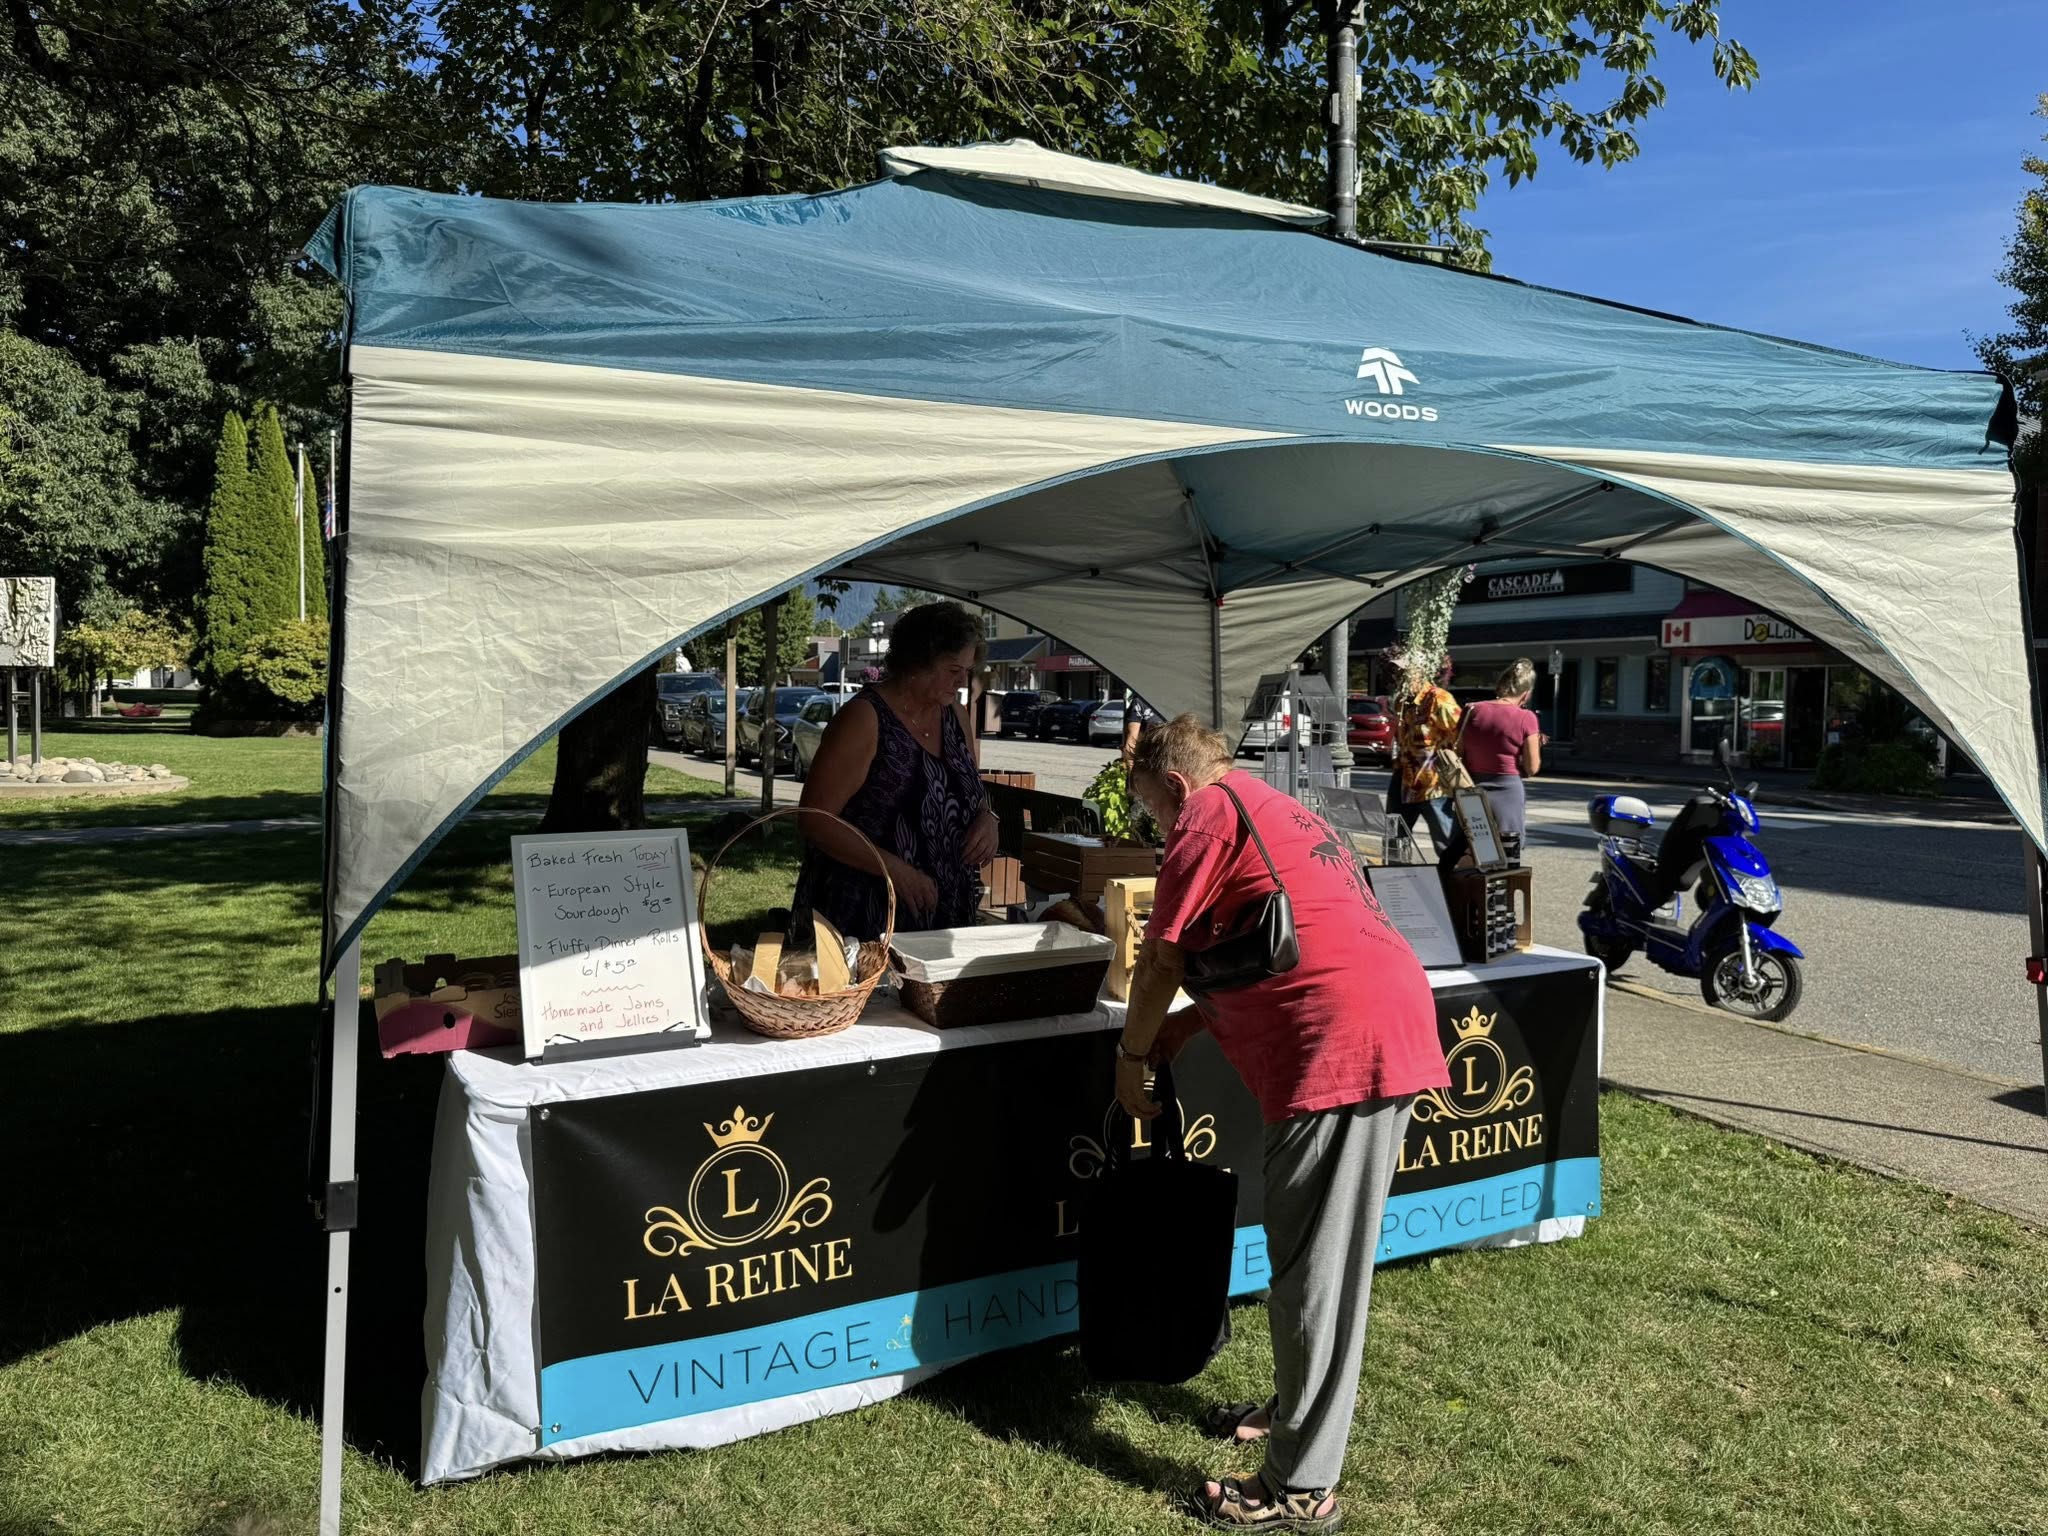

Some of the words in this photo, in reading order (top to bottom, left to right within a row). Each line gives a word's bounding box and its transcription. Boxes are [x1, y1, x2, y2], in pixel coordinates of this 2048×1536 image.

[1345, 400, 1438, 421] WOODS
[1488, 573, 1551, 590] CASCADE
[526, 852, 576, 868] Baked
[582, 848, 623, 866] Fresh
[547, 884, 611, 902] European
[623, 875, 664, 897] Style
[554, 901, 630, 923] Sourdough
[546, 938, 591, 960] Fluffy
[594, 935, 641, 951] Dinner
[647, 928, 679, 946] Rolls
[541, 1000, 613, 1020] Homemade
[622, 996, 665, 1010] Jams
[579, 1020, 604, 1032] and
[1462, 1056, 1489, 1096] L
[1396, 1134, 1441, 1173] LA
[1449, 1113, 1543, 1164] REINE
[721, 1168, 759, 1218] L
[1055, 1200, 1079, 1237] L
[1381, 1181, 1542, 1245] PCYCLED
[623, 1273, 692, 1320] LA
[705, 1238, 853, 1307] REINE
[628, 1321, 872, 1404] VINTAGE
